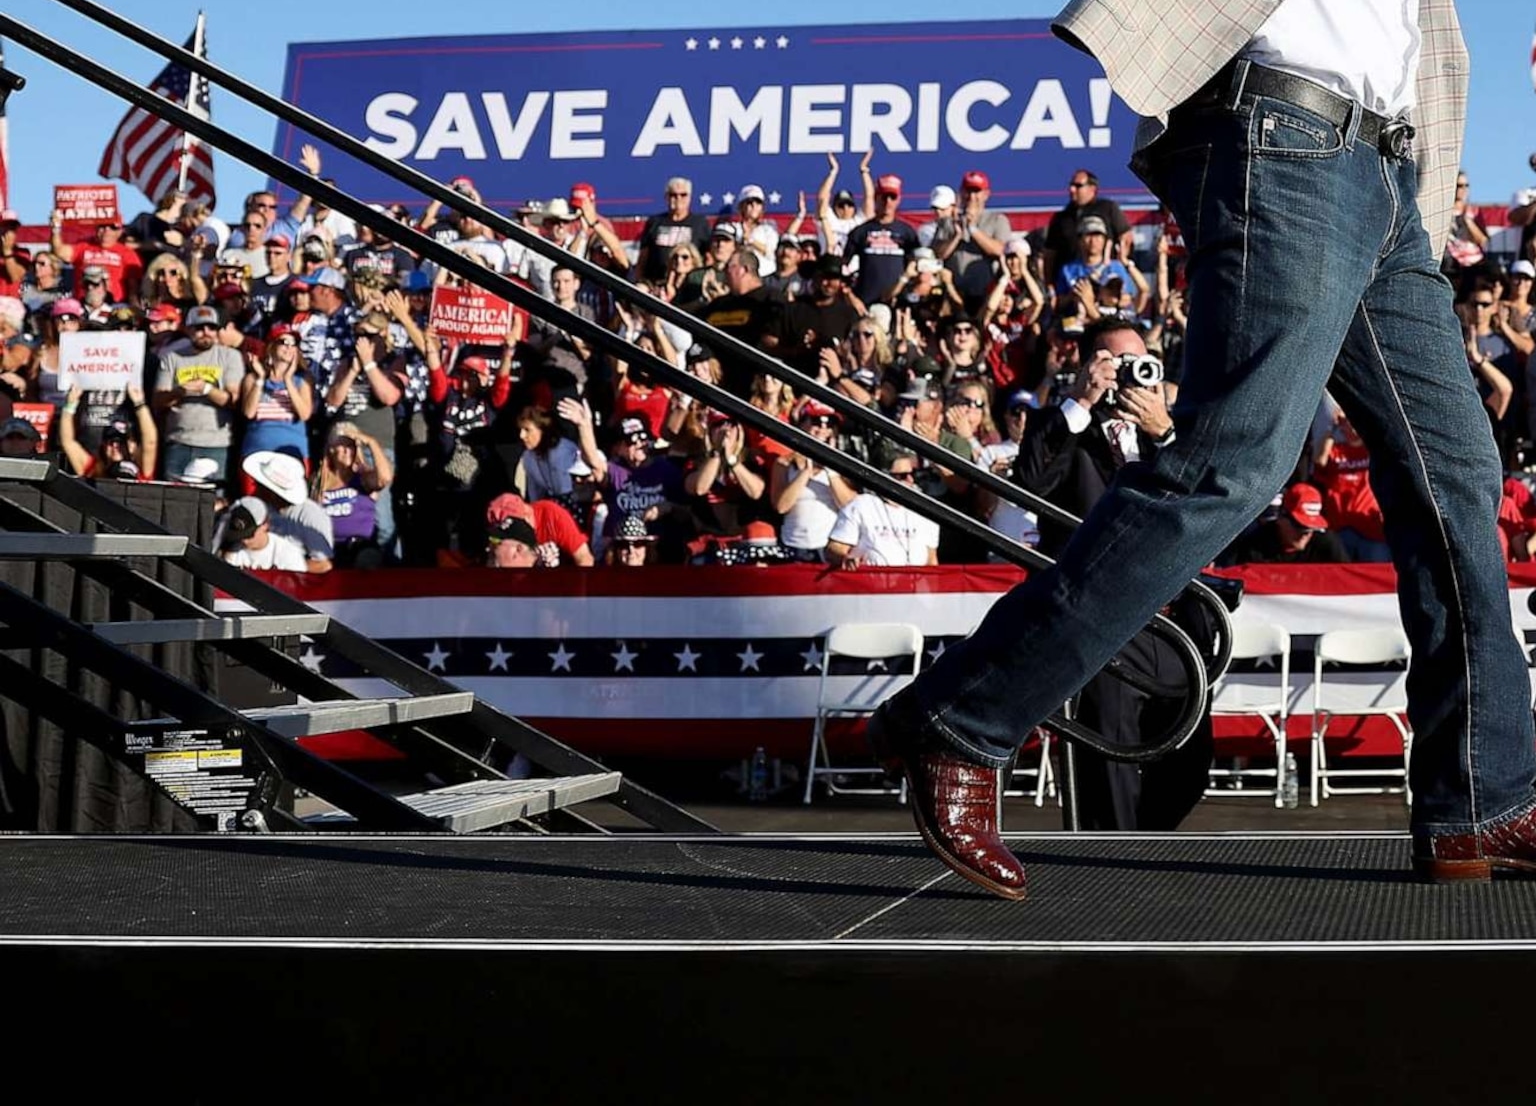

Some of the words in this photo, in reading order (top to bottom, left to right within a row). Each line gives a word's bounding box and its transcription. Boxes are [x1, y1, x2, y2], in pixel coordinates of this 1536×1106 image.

[364, 91, 608, 161] SAVE
[630, 78, 1113, 159] AMERICA!
[433, 304, 509, 324] AMERICA
[82, 347, 119, 358] SAVE
